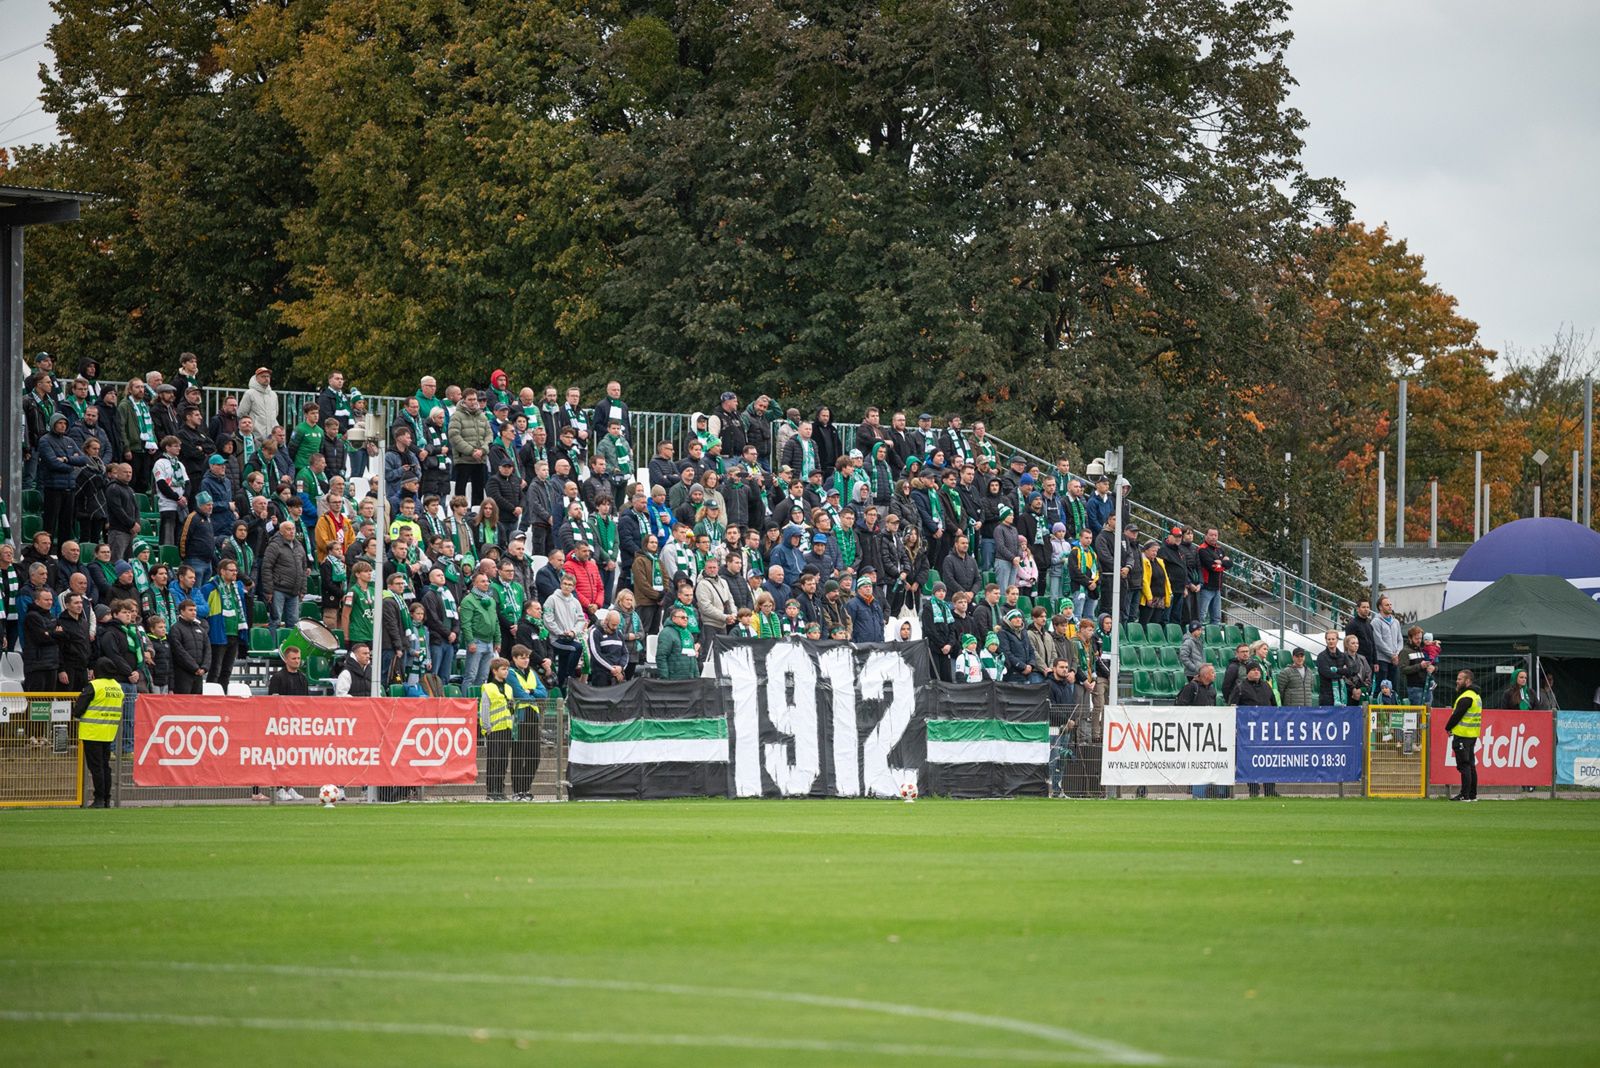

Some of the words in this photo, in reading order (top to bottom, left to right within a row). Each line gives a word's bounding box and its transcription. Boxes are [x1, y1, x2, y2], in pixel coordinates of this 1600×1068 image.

[2, 706, 8, 716] 8
[719, 643, 918, 798] 1912
[265, 717, 357, 736] AGREGATY
[1247, 721, 1351, 741] TELESKOP
[240, 742, 380, 770] PRĄDOTWÓRCZE
[1108, 761, 1139, 769] WYNAJEM
[1140, 760, 1186, 769] PODNOŚNIKÓW
[1191, 760, 1228, 769] RUSZTOWAŃ
[1252, 754, 1309, 767] CODZIENNIE
[1311, 754, 1319, 767] O
[1322, 754, 1346, 767] 18:30
